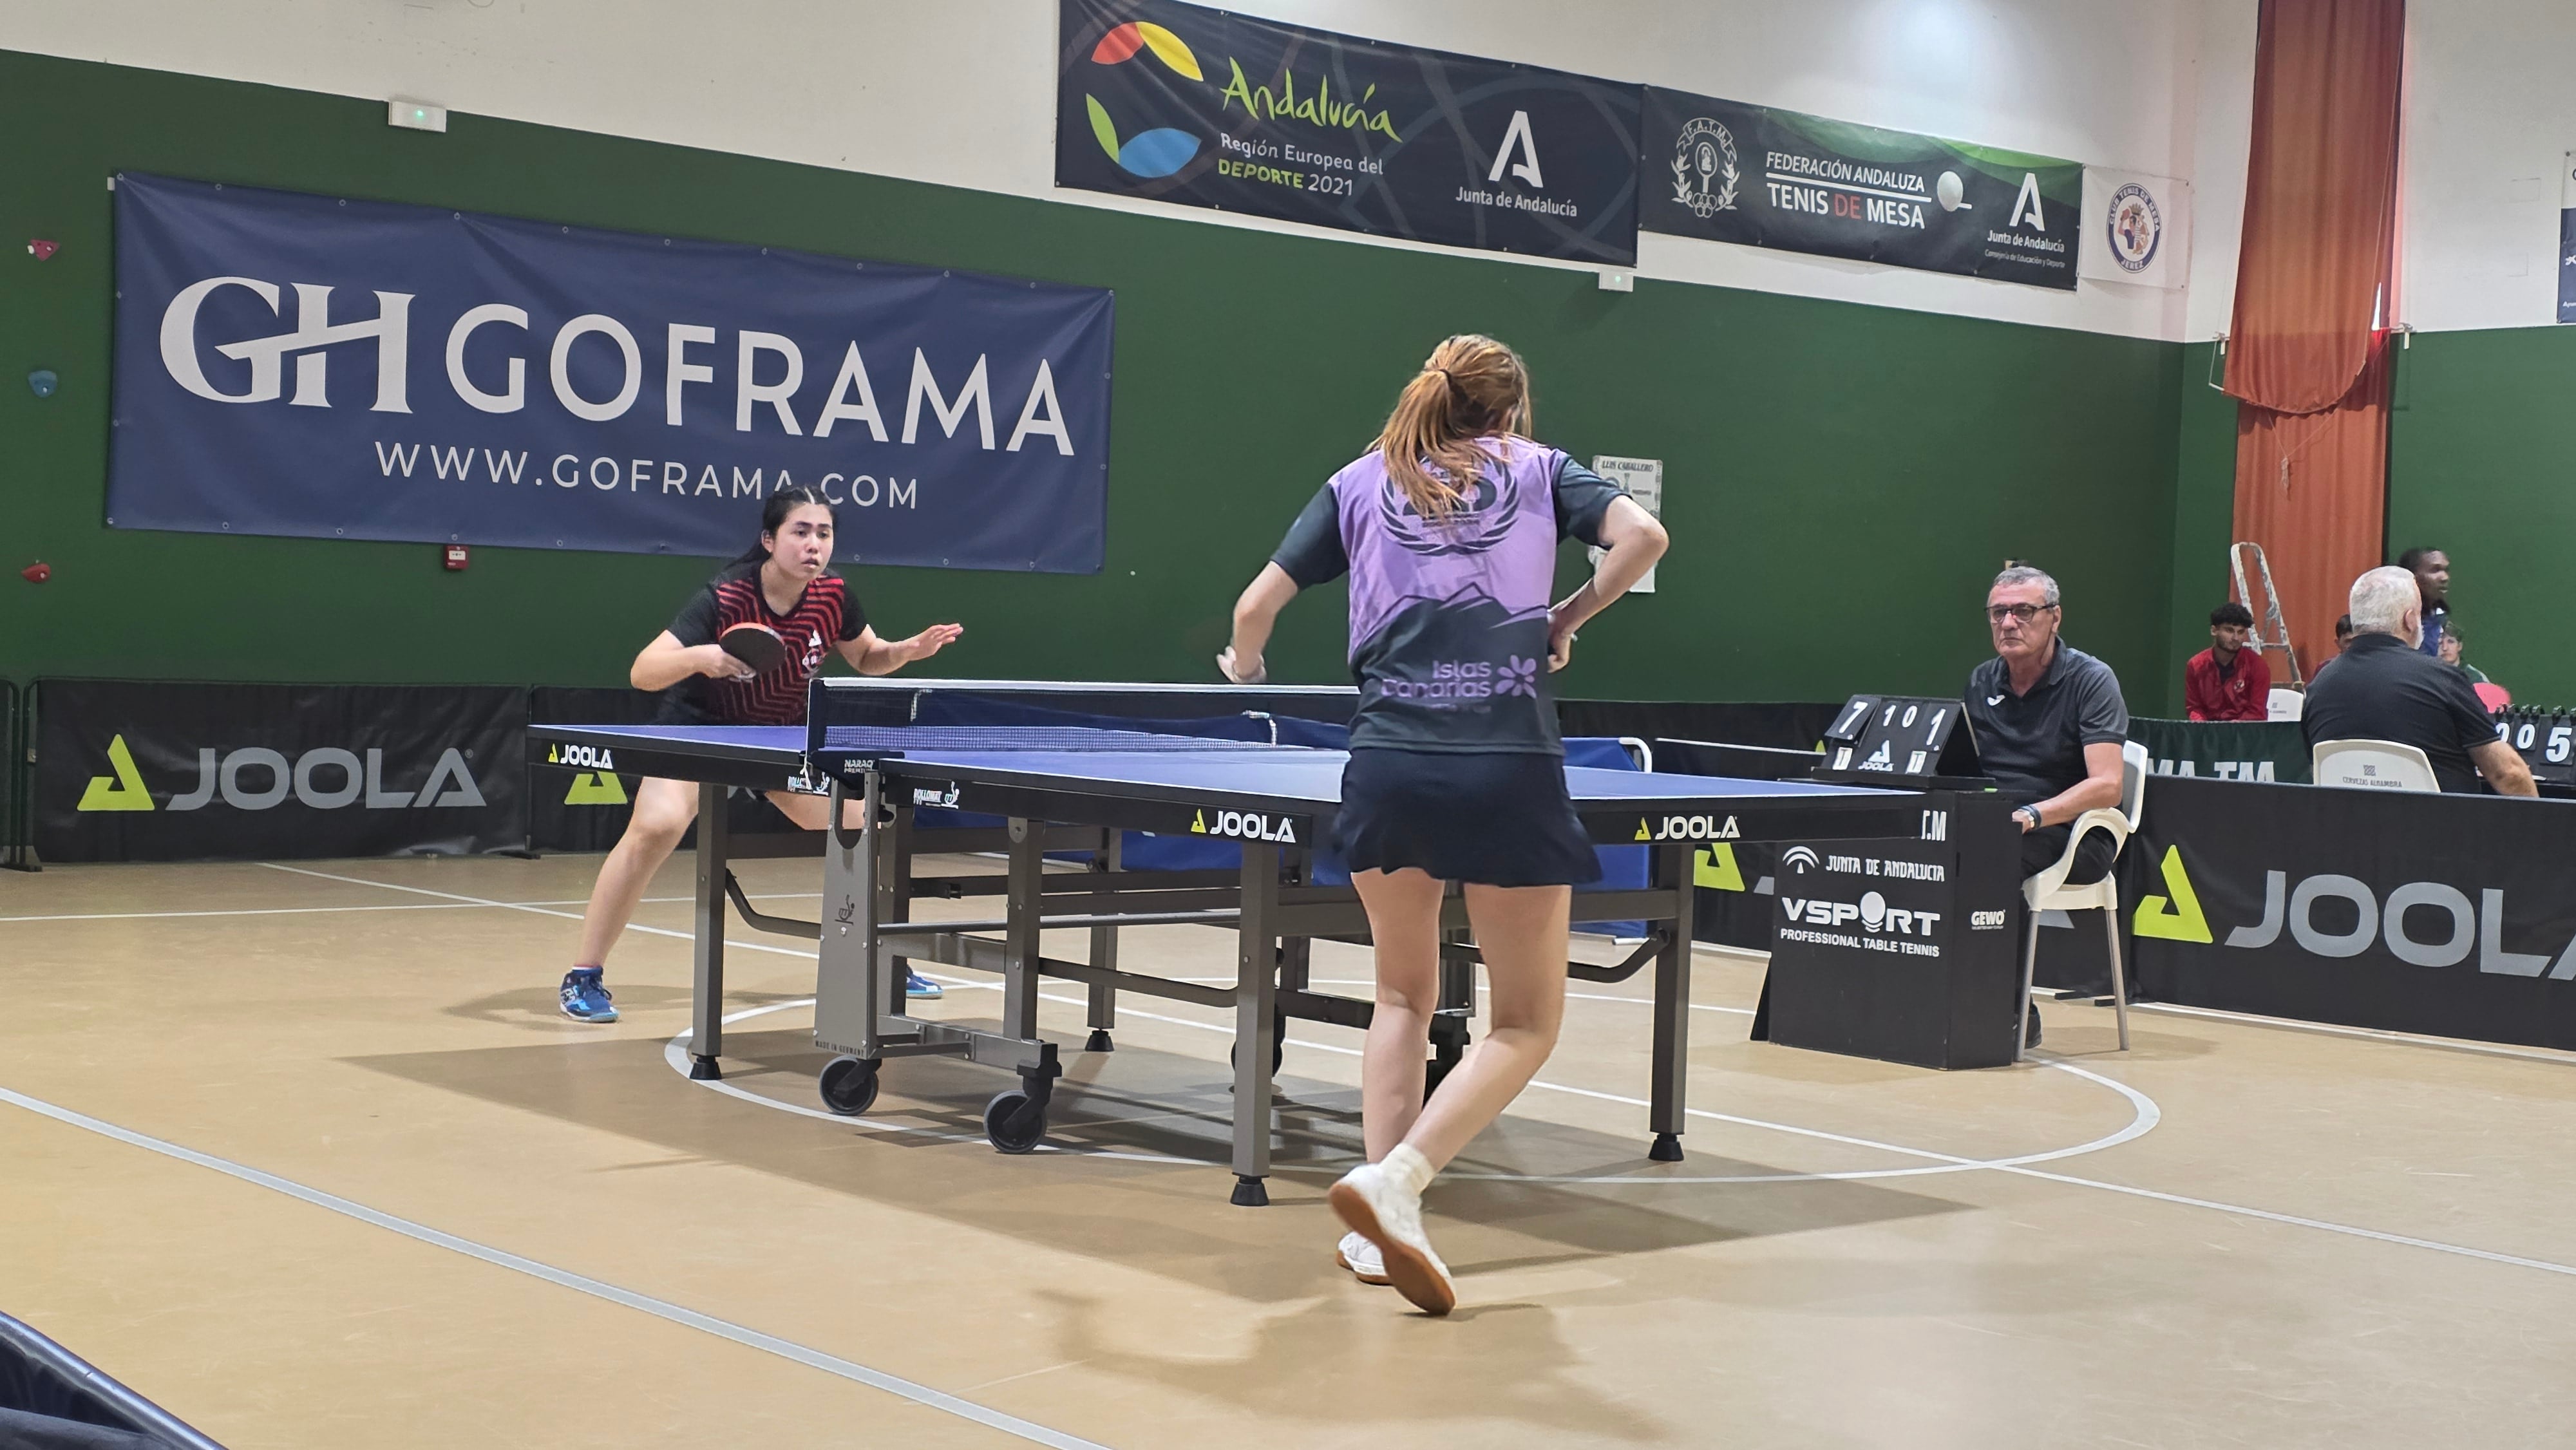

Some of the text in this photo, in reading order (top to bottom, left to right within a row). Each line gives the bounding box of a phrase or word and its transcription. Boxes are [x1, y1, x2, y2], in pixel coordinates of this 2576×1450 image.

[1219, 56, 1403, 143] Andalucía
[1220, 133, 1384, 176] Región Europea del
[1218, 159, 1353, 196] DEPORTE 2021
[1766, 151, 1926, 193] FEDERACIÓN ANDALUZA
[1455, 186, 1577, 217] Junta de Andalucía
[1766, 183, 1926, 229] TENIS DE MESA
[2109, 196, 2120, 225] CLUB
[2119, 187, 2139, 199] TENIS
[2139, 189, 2149, 203] DE
[1987, 229, 2065, 252] Junta de Andalucía
[2121, 258, 2145, 270] JEREZ
[446, 304, 1074, 456] GOFRAMA
[375, 441, 918, 509] WWW.GOFRAMACOM
[560, 744, 613, 769] JOOLA
[2517, 724, 2535, 749] 0
[2546, 727, 2573, 762] 5
[166, 747, 487, 811] JOOLA
[1858, 761, 1893, 771] JOOLA
[1210, 811, 1296, 843] JOOLA
[1655, 815, 1740, 840] JOOLA
[1826, 854, 1861, 874] JUNTA
[1866, 859, 1880, 876] DE
[1971, 910, 2005, 925] GEWO
[1781, 928, 1940, 957] PROFESSIONAL TABLE TENNIS
[815, 1040, 829, 1050] MADE
